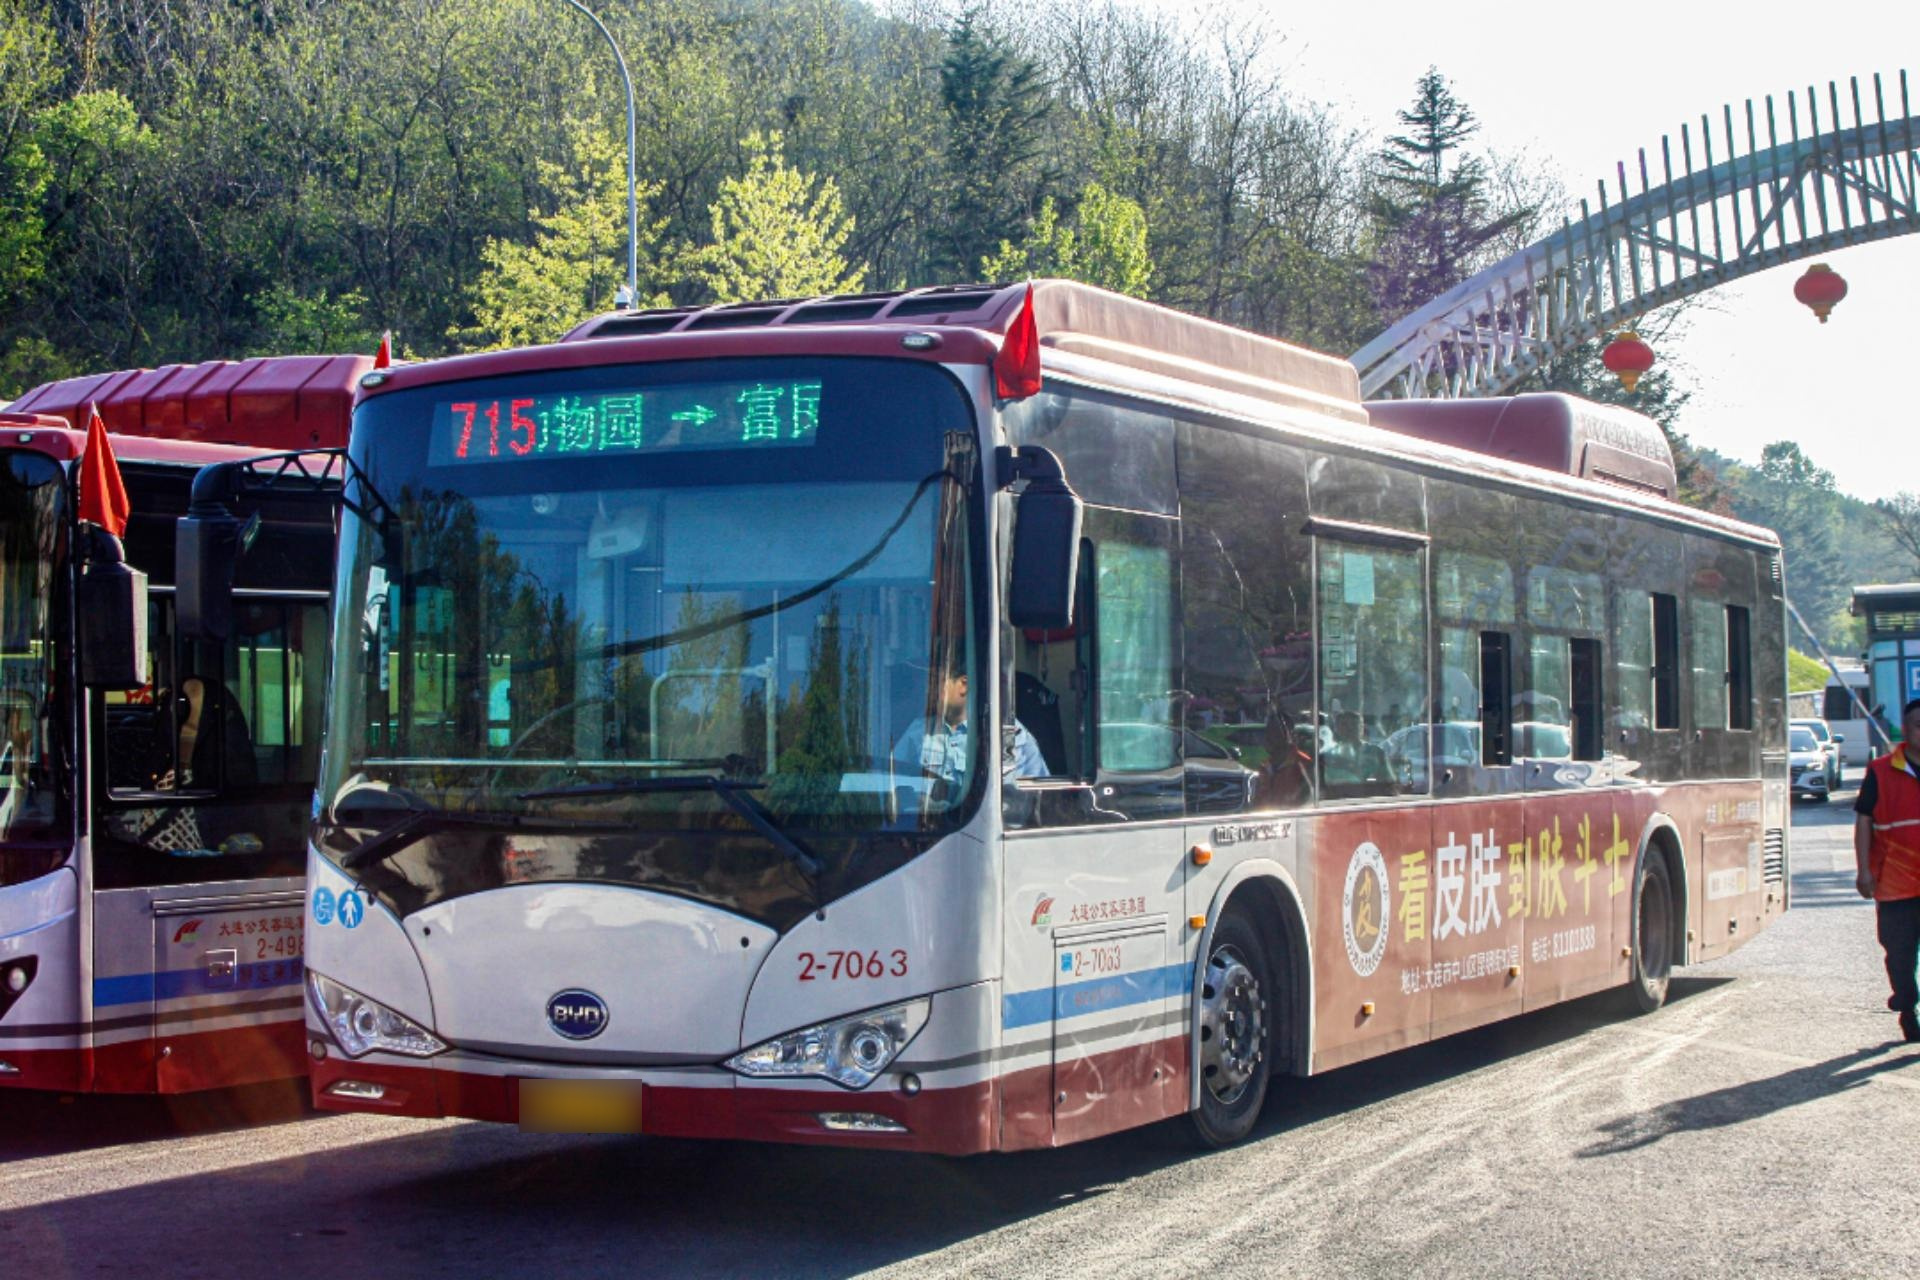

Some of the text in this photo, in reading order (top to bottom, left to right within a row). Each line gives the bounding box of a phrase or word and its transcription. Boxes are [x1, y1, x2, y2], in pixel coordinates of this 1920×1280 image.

[451, 398, 536, 457] 715
[798, 949, 908, 981] 2-7063
[1075, 945, 1121, 977] 2-7063
[554, 1004, 600, 1024] BYD
